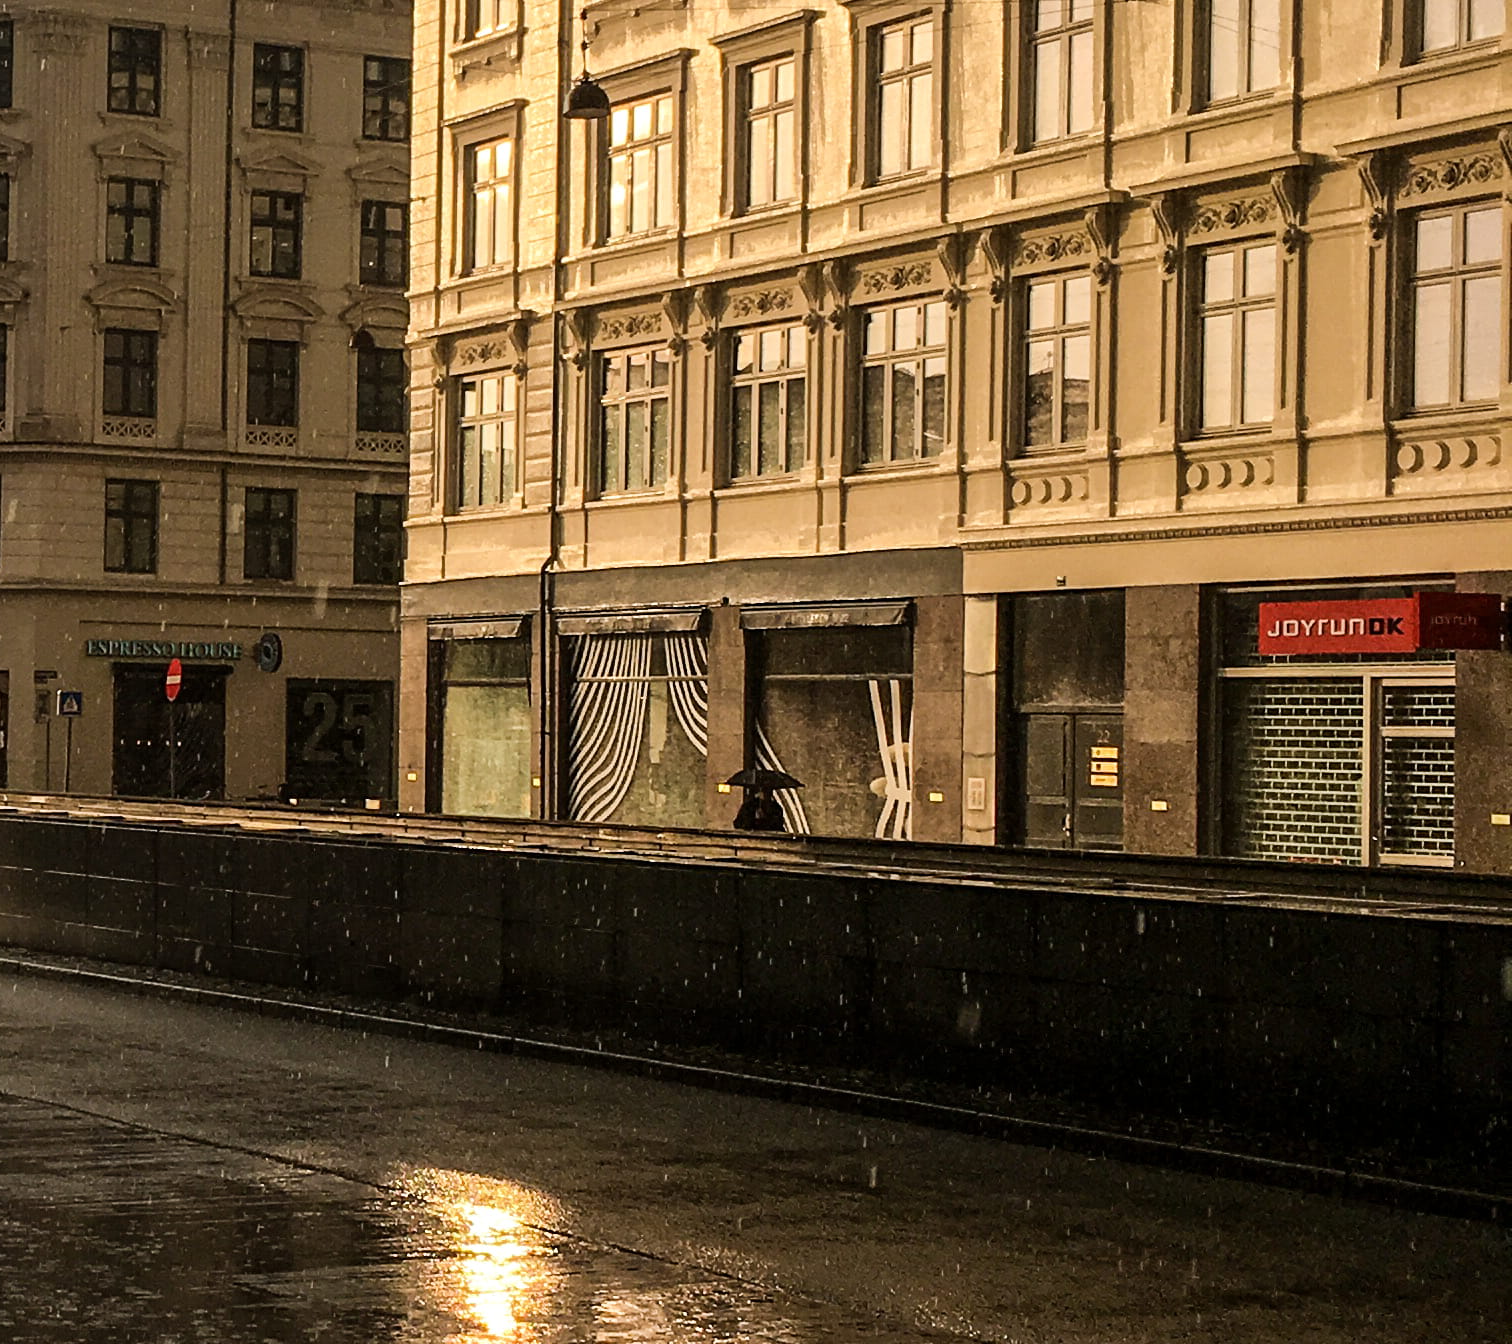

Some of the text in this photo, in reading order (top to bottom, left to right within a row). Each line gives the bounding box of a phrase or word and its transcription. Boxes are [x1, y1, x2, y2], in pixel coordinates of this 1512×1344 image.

[87, 640, 179, 657] ESPRESSO
[181, 642, 243, 658] HOUSE
[303, 692, 376, 763] 25
[1097, 729, 1110, 743] 22
